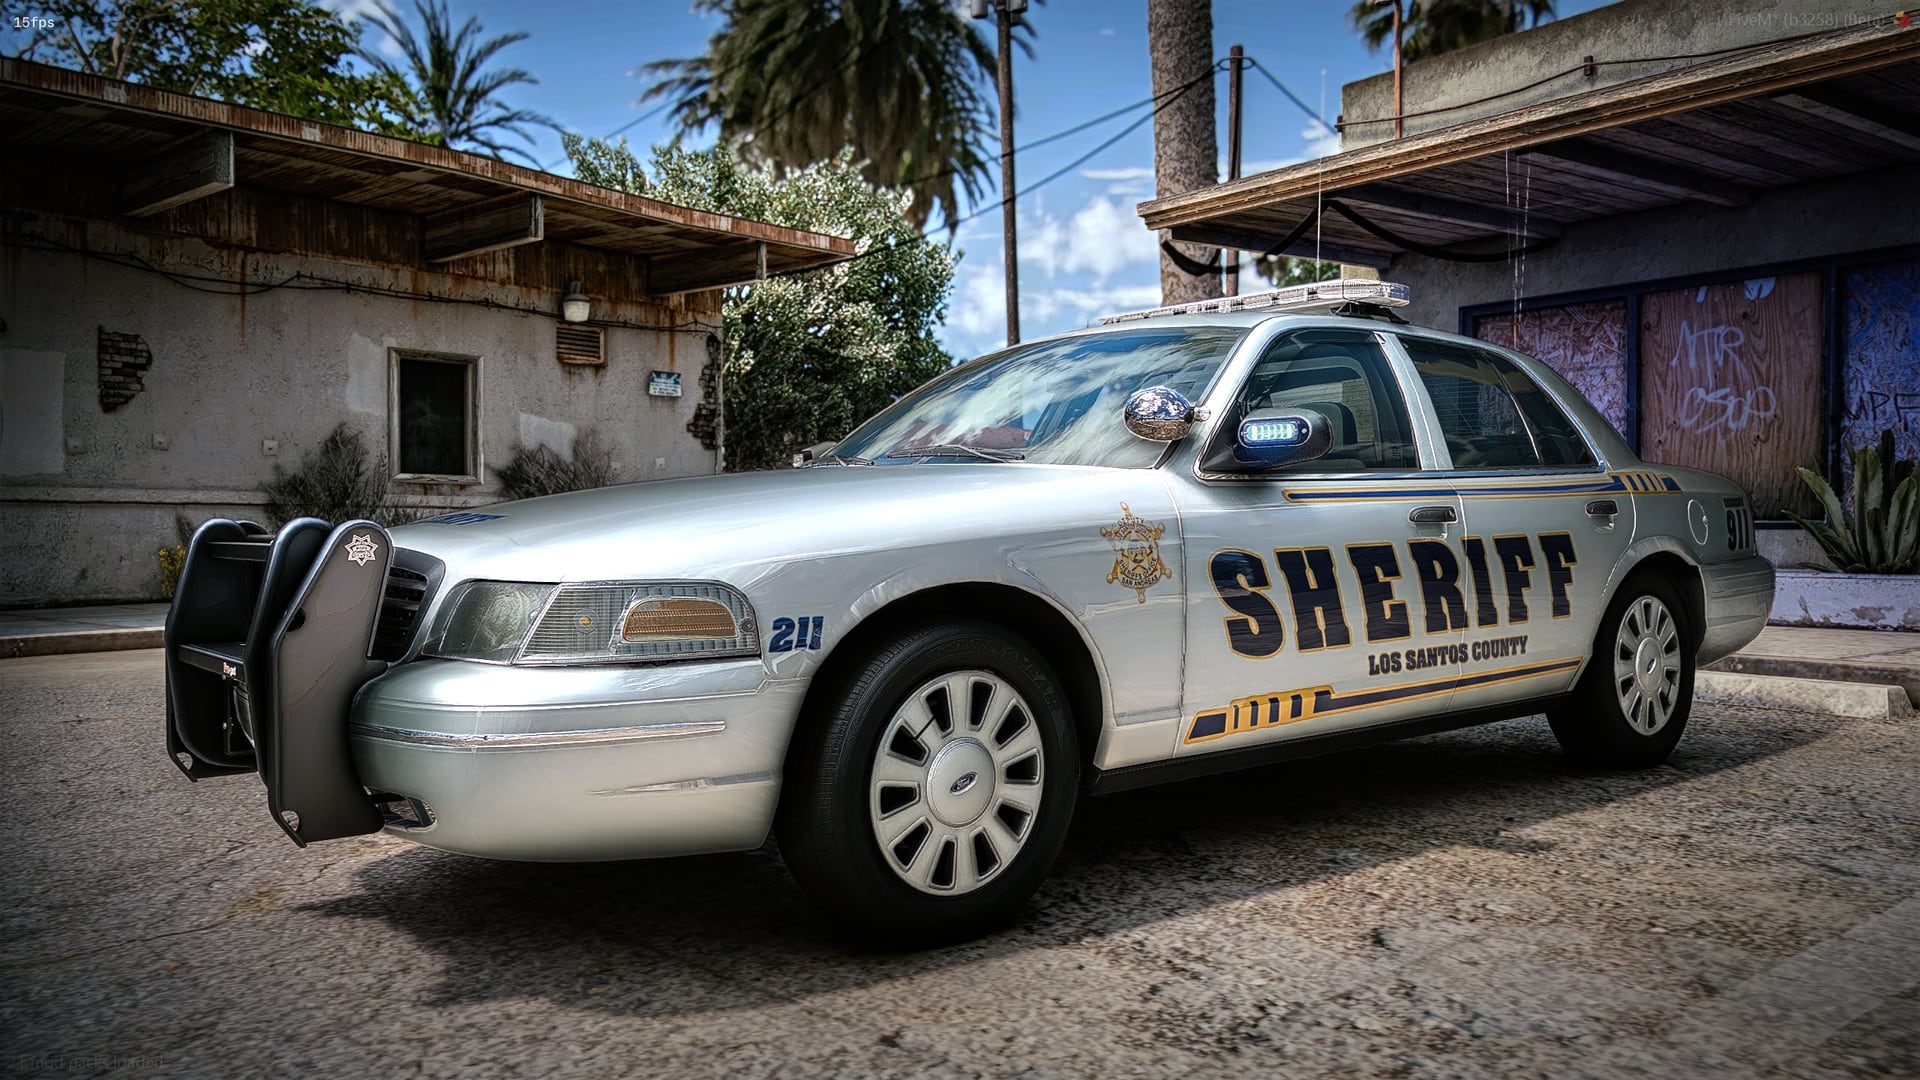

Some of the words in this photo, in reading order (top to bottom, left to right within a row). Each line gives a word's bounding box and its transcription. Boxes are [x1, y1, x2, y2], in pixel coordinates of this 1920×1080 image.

[1727, 509, 1750, 551] 911
[1208, 535, 1577, 660] SHERIFF
[769, 616, 824, 653] 211
[1368, 653, 1402, 676] LOS
[1405, 643, 1468, 671] SANTOS
[1471, 635, 1528, 661] COUNTY
